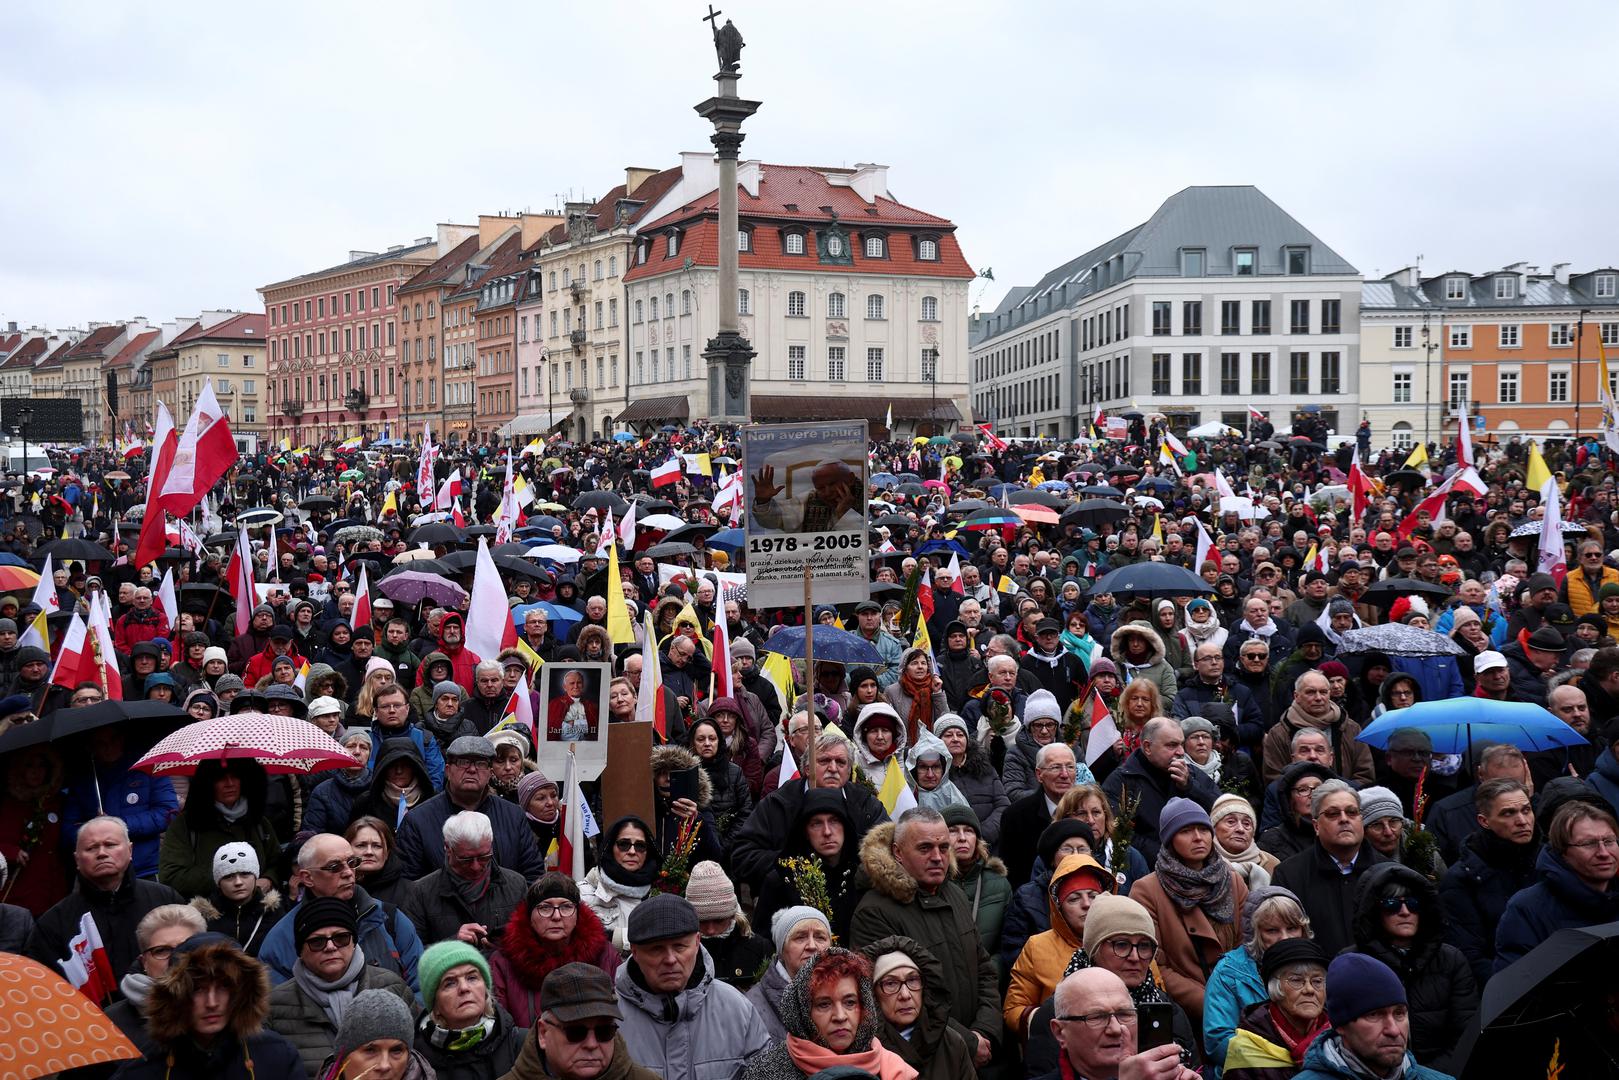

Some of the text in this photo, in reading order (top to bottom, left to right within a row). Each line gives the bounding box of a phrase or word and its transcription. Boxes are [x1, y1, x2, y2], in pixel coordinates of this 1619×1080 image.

[748, 427, 861, 441] Non avere paura
[750, 537, 798, 553] 1978
[814, 534, 862, 550] 2005
[548, 726, 563, 734] Jan
